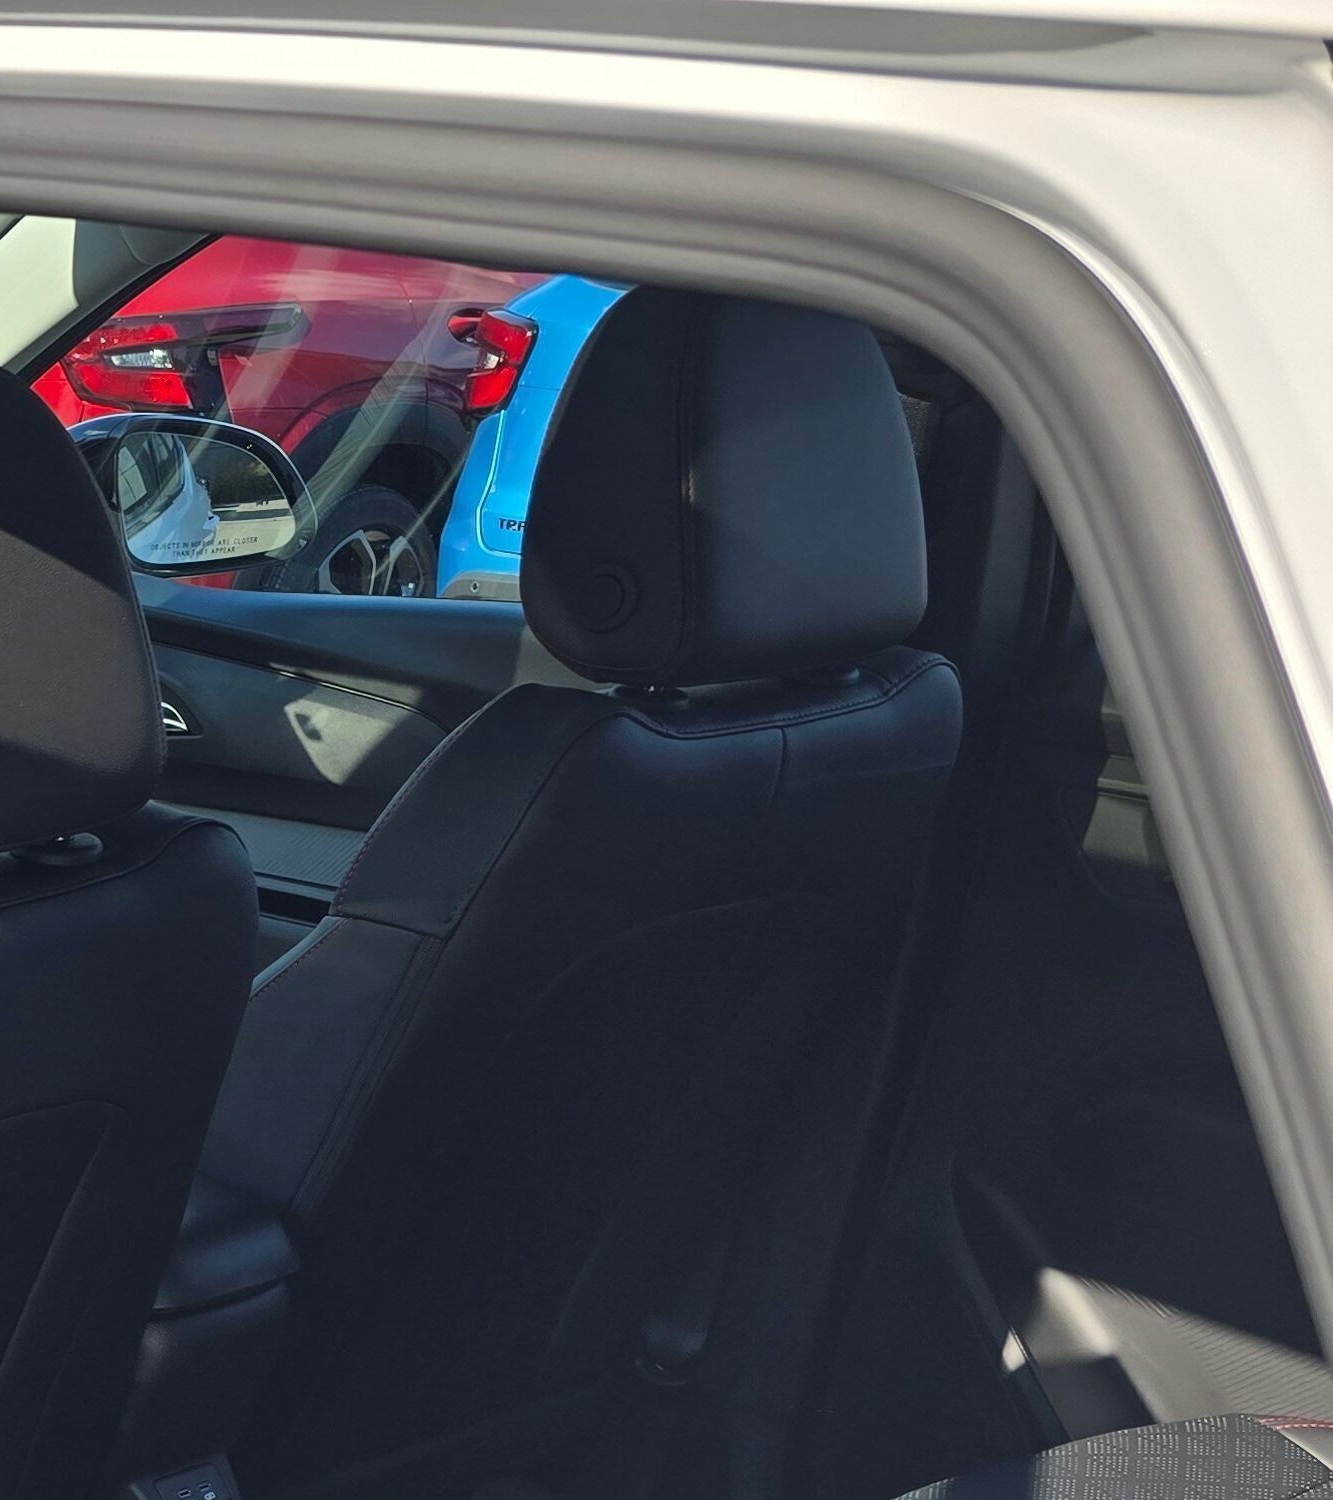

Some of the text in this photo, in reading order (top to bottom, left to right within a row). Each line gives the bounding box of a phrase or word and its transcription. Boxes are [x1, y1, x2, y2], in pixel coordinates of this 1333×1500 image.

[499, 518, 527, 532] TRA
[150, 541, 181, 551] OBJECTS
[233, 536, 258, 545] CLOSER
